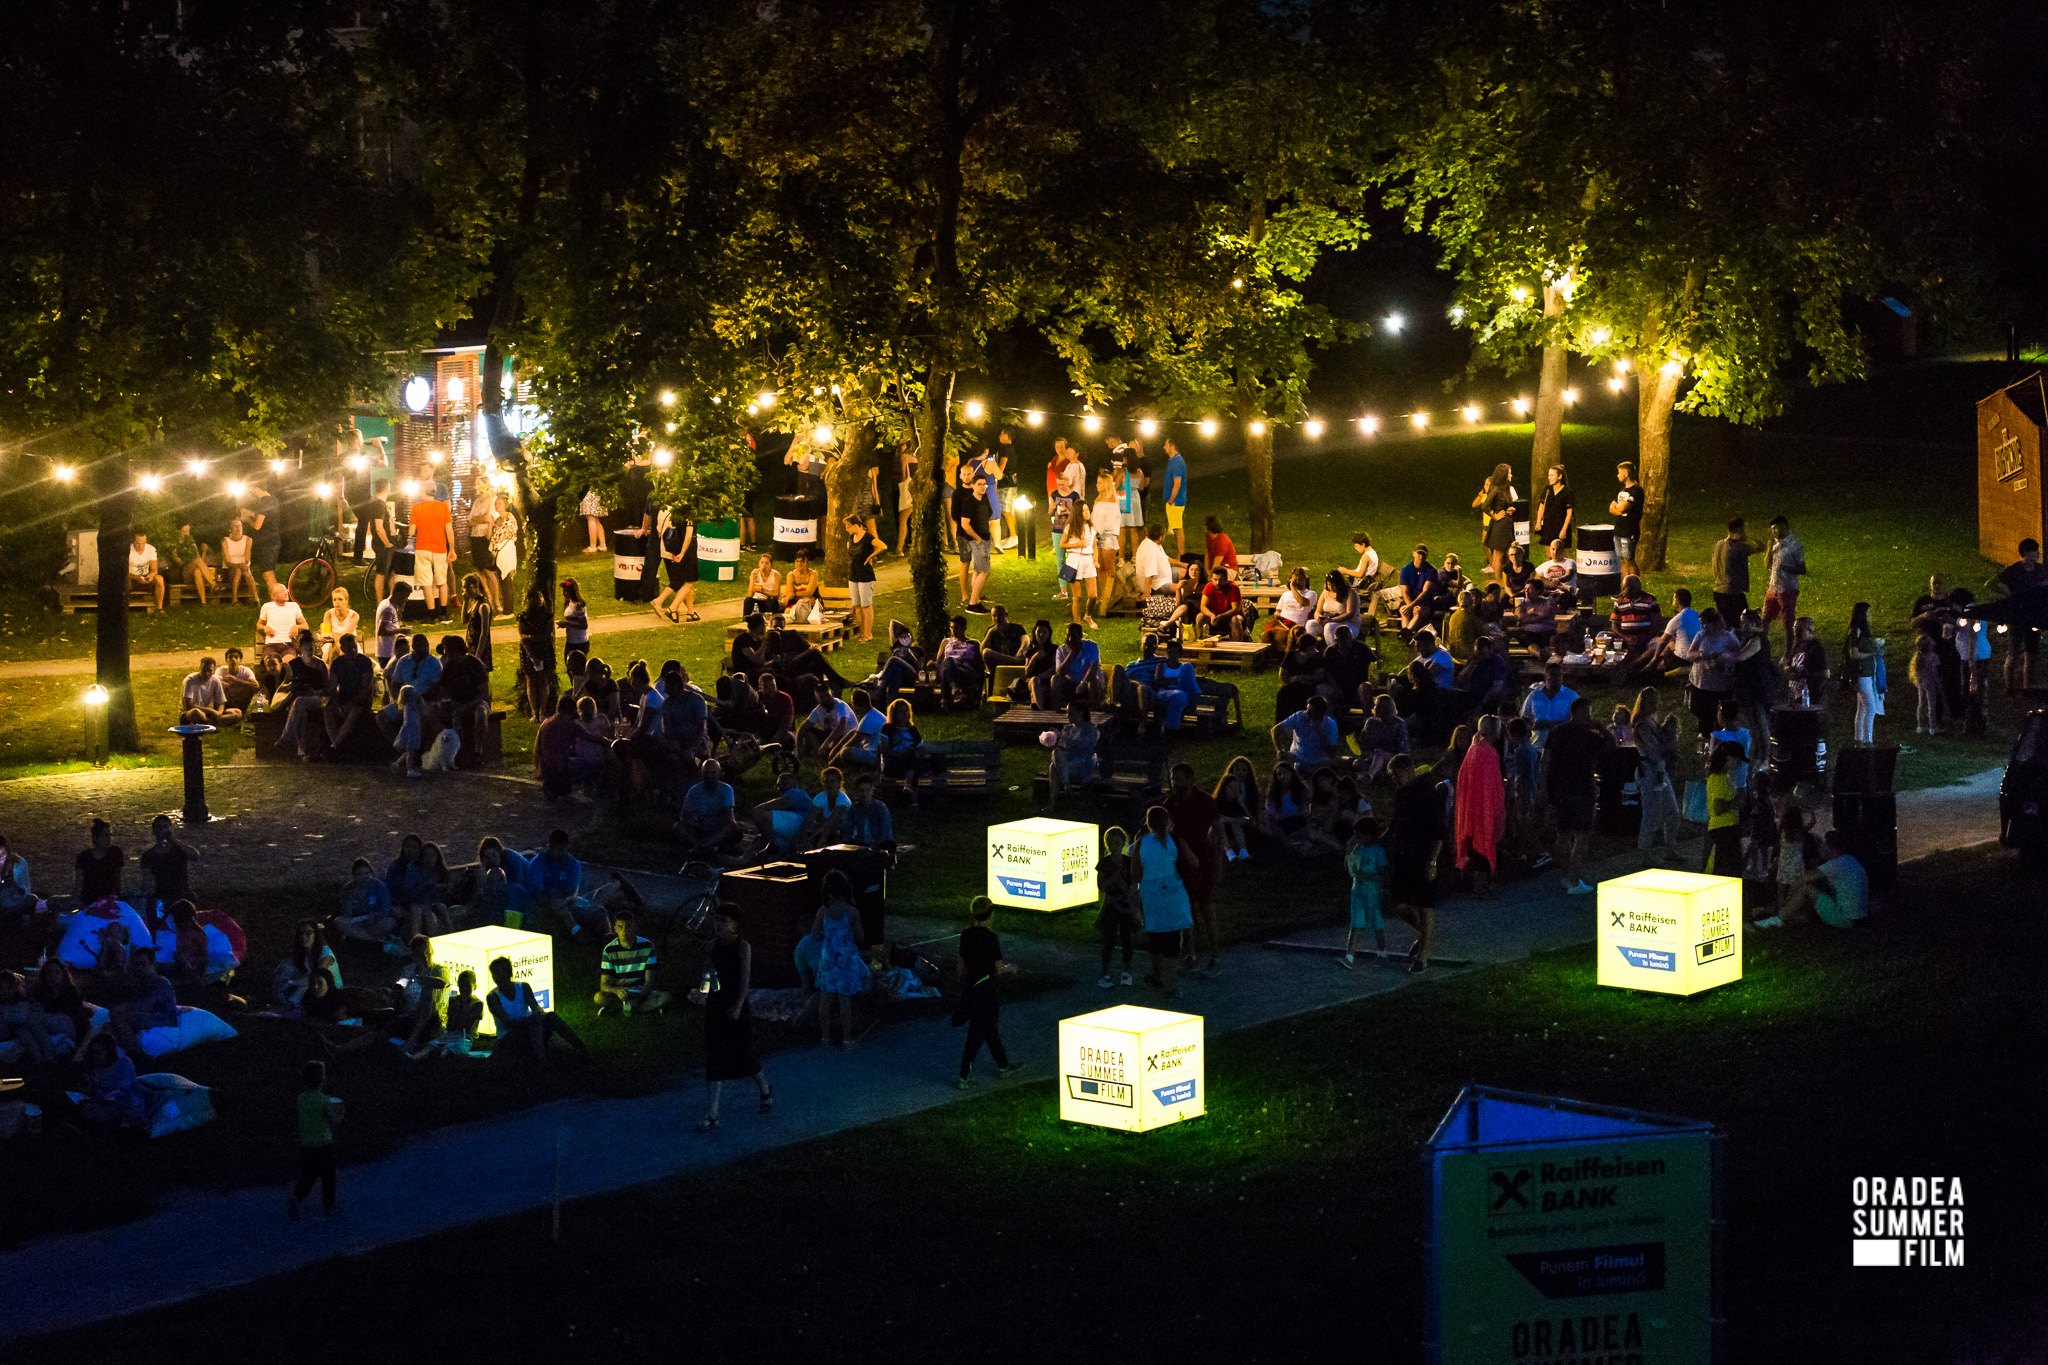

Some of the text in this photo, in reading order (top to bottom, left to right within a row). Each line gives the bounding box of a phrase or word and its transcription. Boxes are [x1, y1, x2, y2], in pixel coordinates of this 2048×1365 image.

[779, 525, 809, 535] ORADEA
[1007, 844, 1047, 856] Raiffeisen
[1062, 845, 1089, 861] ORADEA
[1007, 854, 1031, 865] BANK
[1062, 857, 1089, 872] SUMMER
[1074, 870, 1089, 882] FILM
[1629, 911, 1677, 925] Raiffeisen
[1702, 907, 1730, 927] ORADEA
[1629, 923, 1658, 934] BANK
[1702, 922, 1730, 941] SUMMER
[1714, 937, 1730, 954] FILM
[511, 955, 549, 968] aiffeisen
[514, 967, 533, 979] ANK
[1080, 1046, 1125, 1067] ORADEA
[1161, 1044, 1196, 1059] Raiffeisen
[1080, 1063, 1125, 1082] SUMMER
[1161, 1059, 1183, 1071] BANK
[1101, 1083, 1125, 1100] FILM
[1540, 1155, 1666, 1184] Raiffeisen
[1541, 1185, 1618, 1213] BANK
[1539, 1251, 1646, 1275] Punem Filmul
[1512, 1312, 1643, 1357] ORADEA
